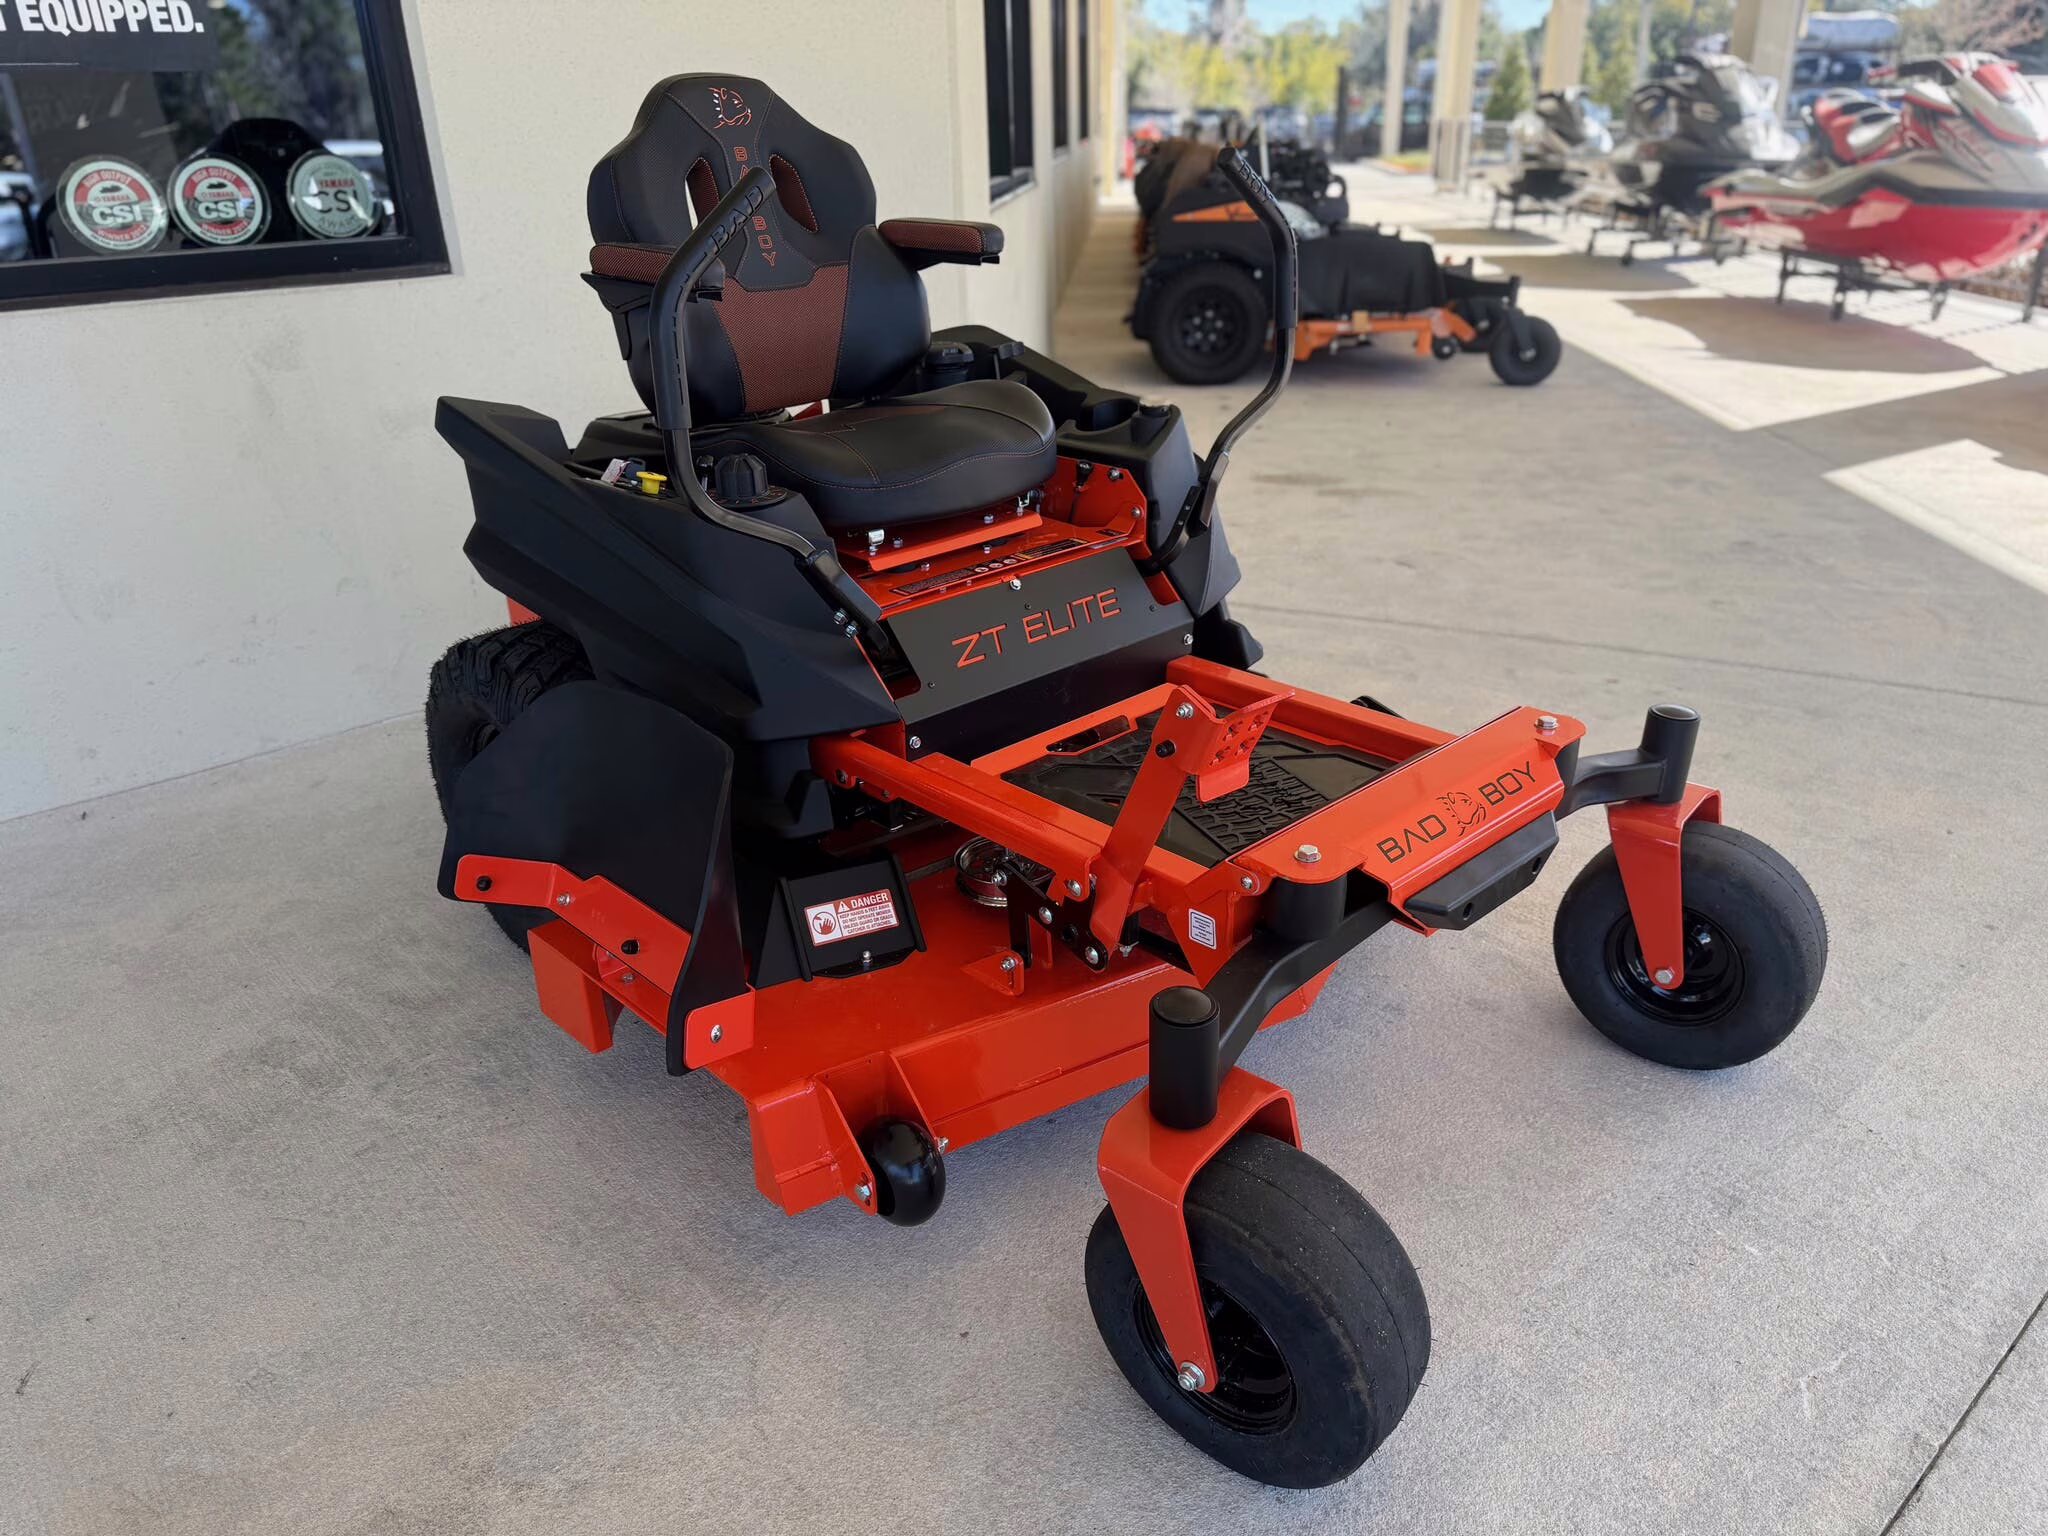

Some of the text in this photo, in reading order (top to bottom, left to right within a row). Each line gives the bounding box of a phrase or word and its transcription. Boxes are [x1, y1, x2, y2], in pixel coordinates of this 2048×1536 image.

[16, 0, 205, 37] EQUIPPED.
[319, 178, 356, 188] YAMAHA
[92, 204, 143, 225] CSI
[198, 200, 246, 219] CSI
[711, 185, 764, 255] BAD
[752, 216, 777, 267] BOY
[951, 587, 1121, 668] ZT ELITE
[1376, 760, 1536, 863] BAD BOY
[850, 892, 889, 909] DANGER
